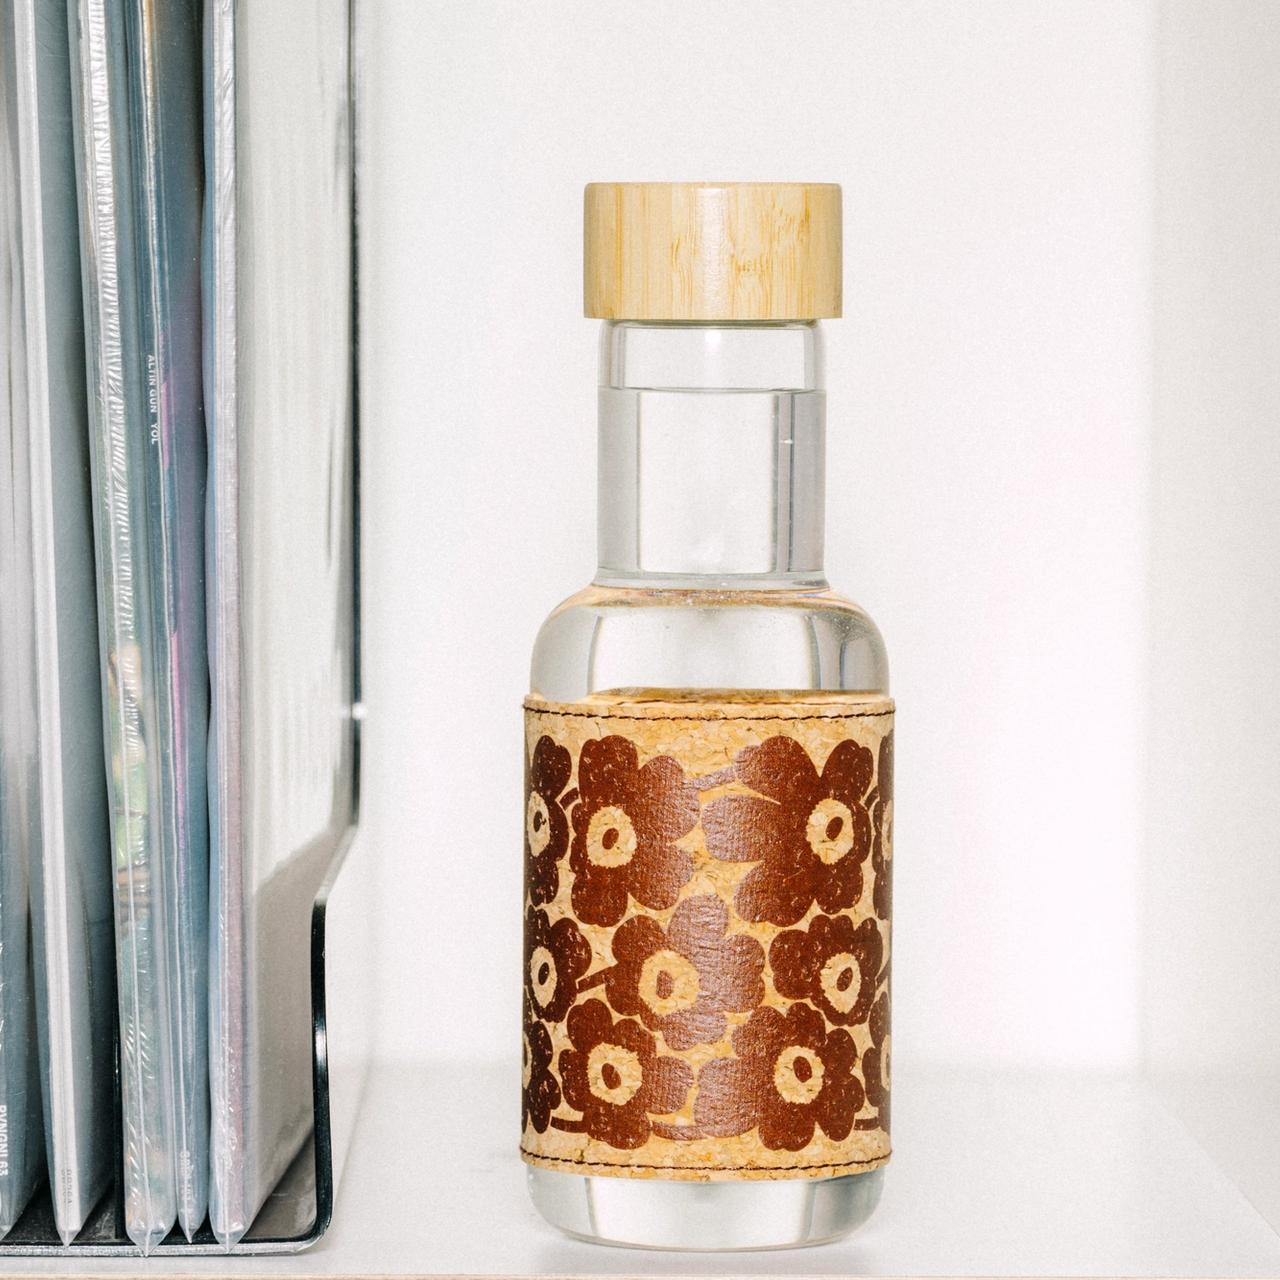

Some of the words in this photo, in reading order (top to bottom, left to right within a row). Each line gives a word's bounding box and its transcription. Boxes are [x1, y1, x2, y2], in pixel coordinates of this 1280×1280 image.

[145, 354, 157, 386] ALTIN
[146, 388, 158, 414] GUN
[148, 421, 160, 444] YOL
